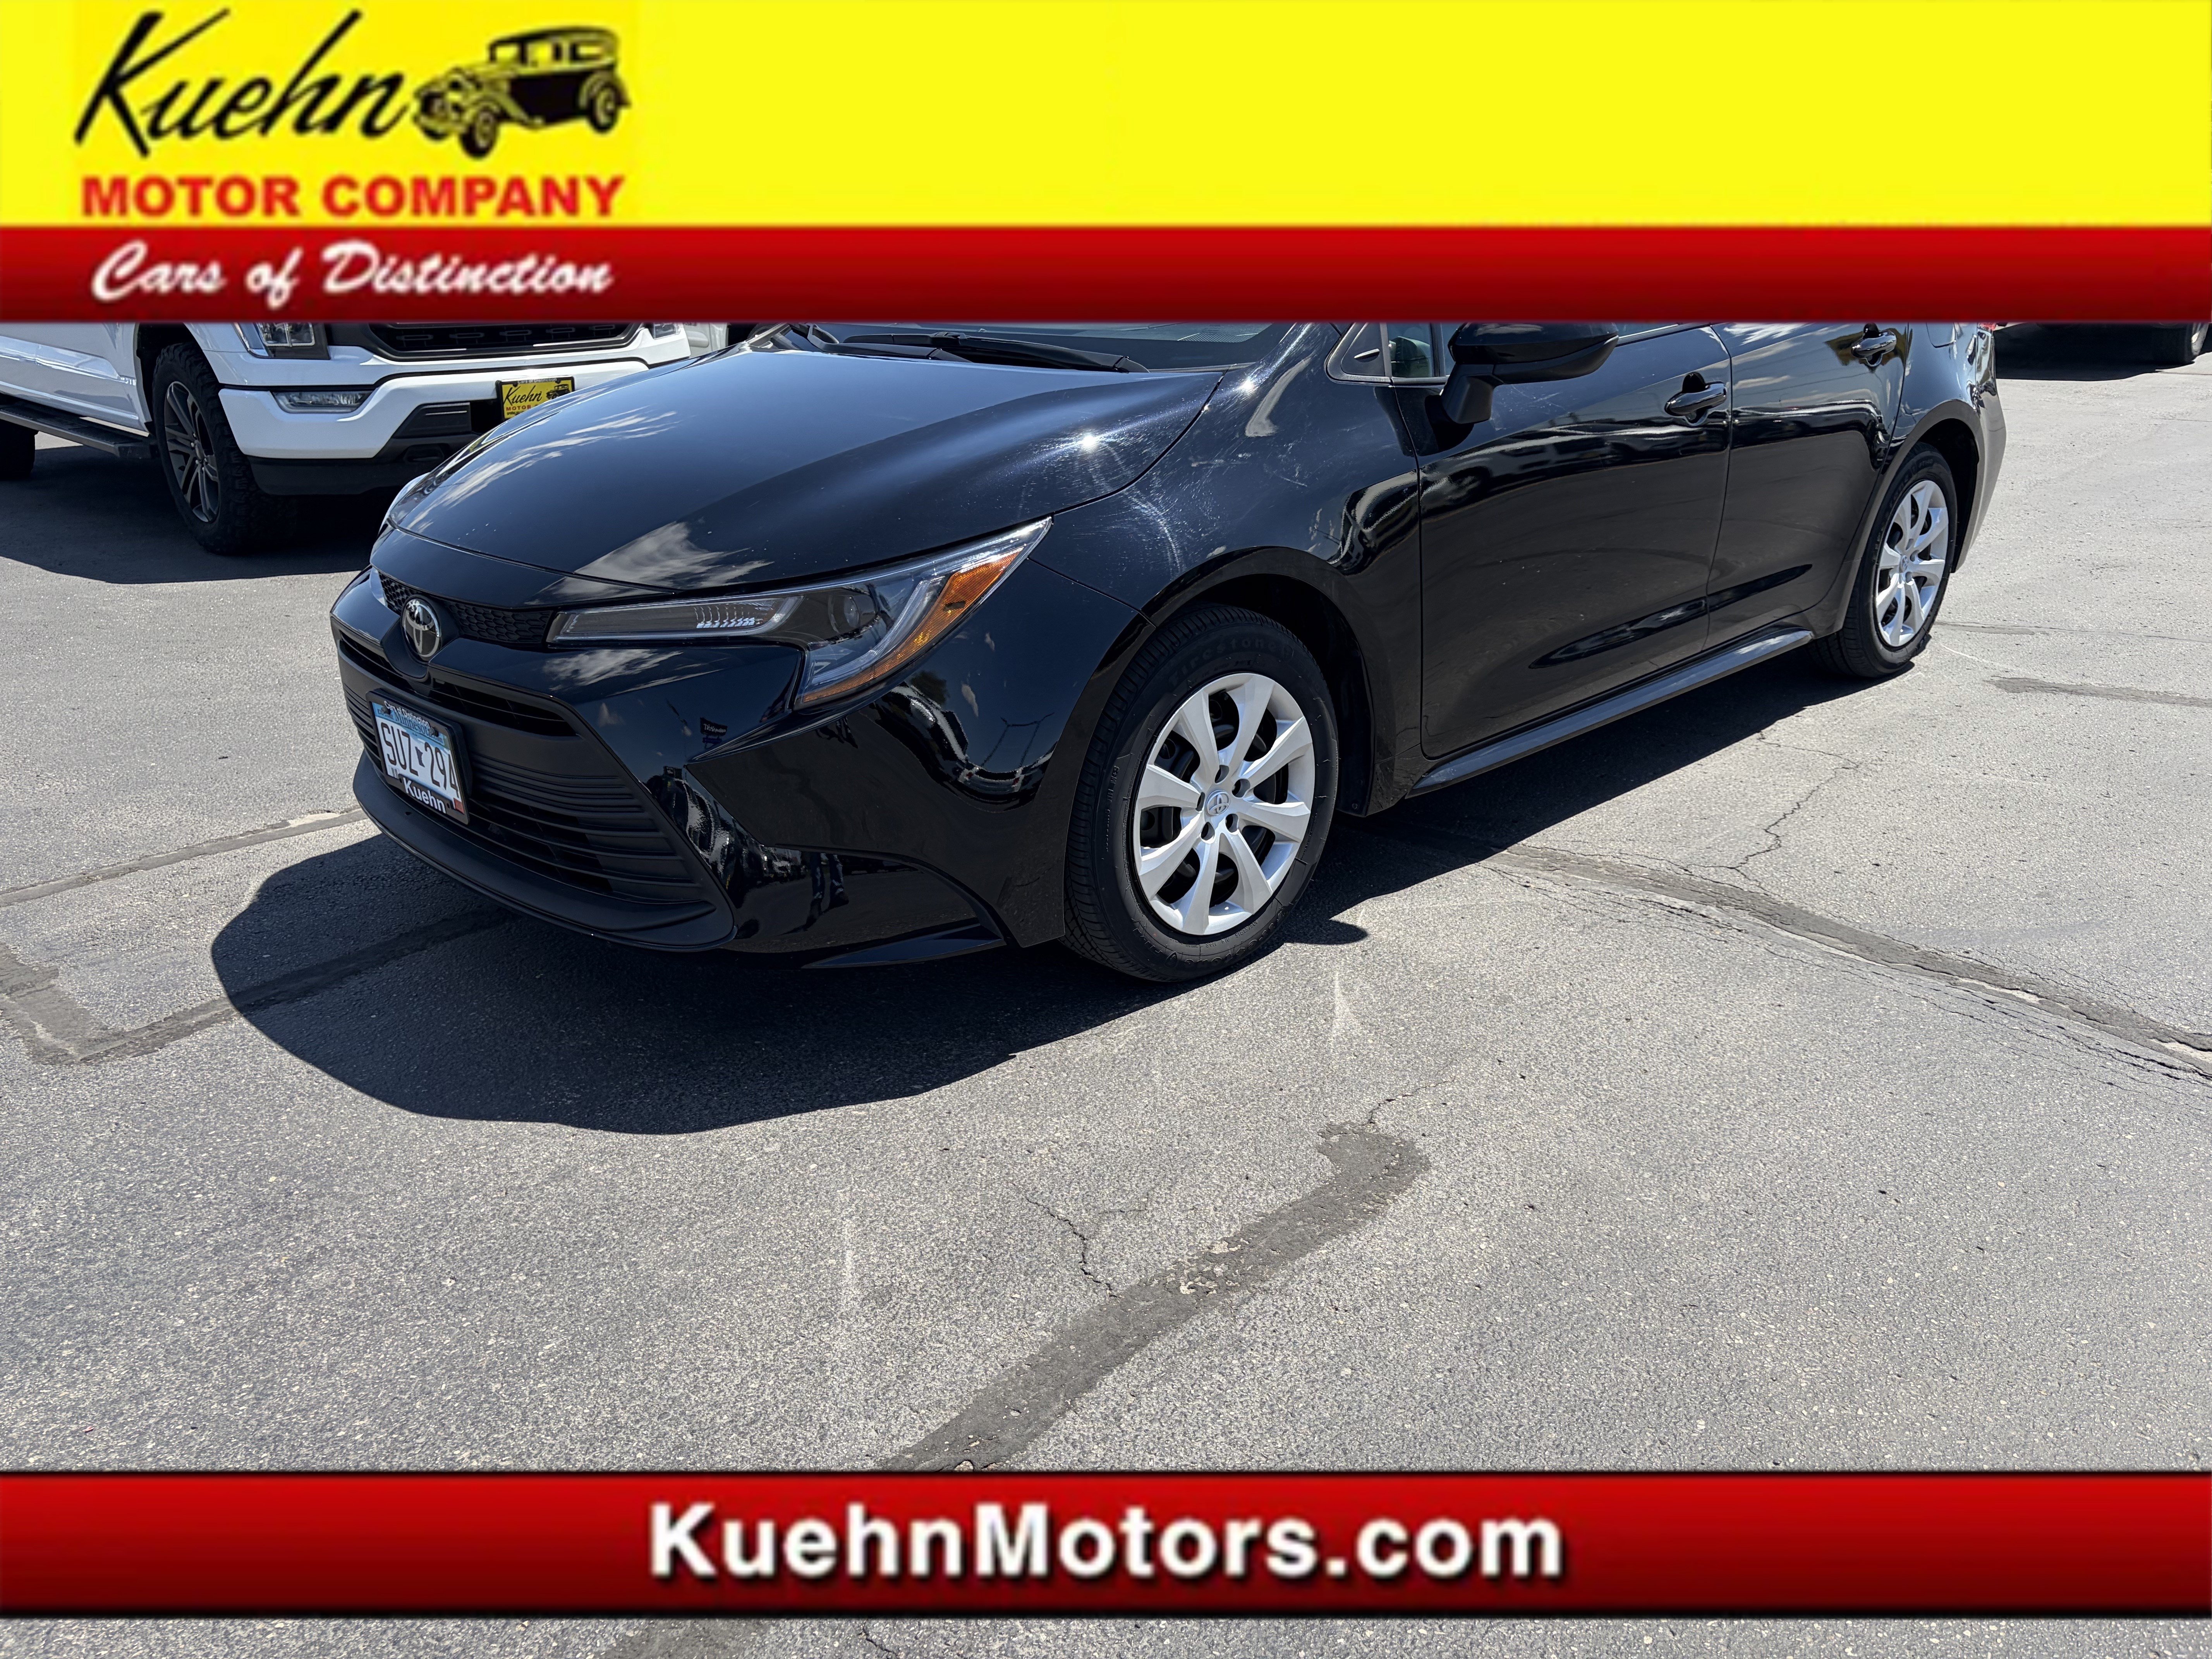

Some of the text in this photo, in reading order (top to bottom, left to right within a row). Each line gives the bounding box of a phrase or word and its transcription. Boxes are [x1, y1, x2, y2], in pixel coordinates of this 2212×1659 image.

[503, 385, 542, 406] Kuehn
[381, 722, 459, 799] SUZ 294
[403, 777, 446, 814] Kuehn
